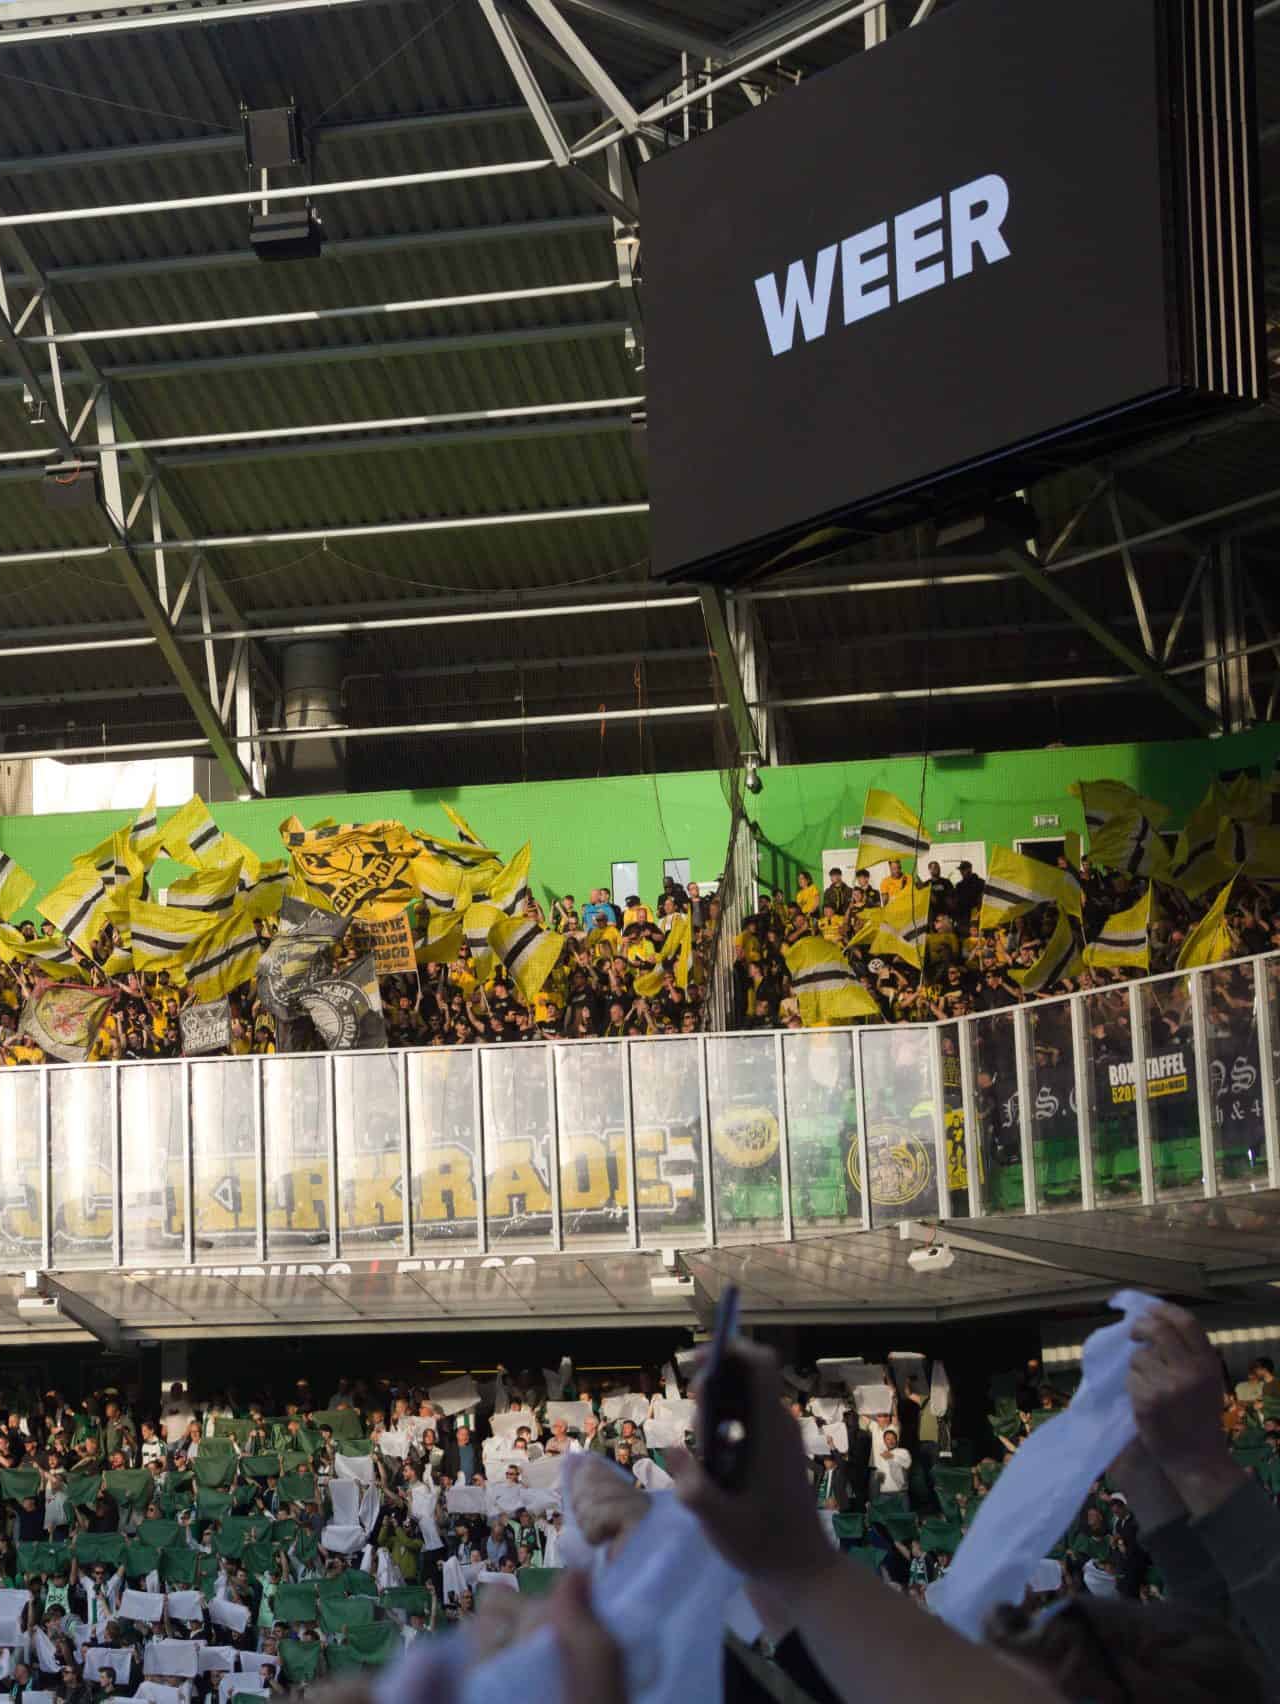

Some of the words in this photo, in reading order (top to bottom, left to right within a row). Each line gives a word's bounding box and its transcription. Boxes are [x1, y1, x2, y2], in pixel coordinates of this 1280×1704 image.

[754, 172, 1011, 356] WEER
[1108, 1052, 1187, 1086] BOXTAFFEL
[165, 1128, 673, 1237] KERKRADE
